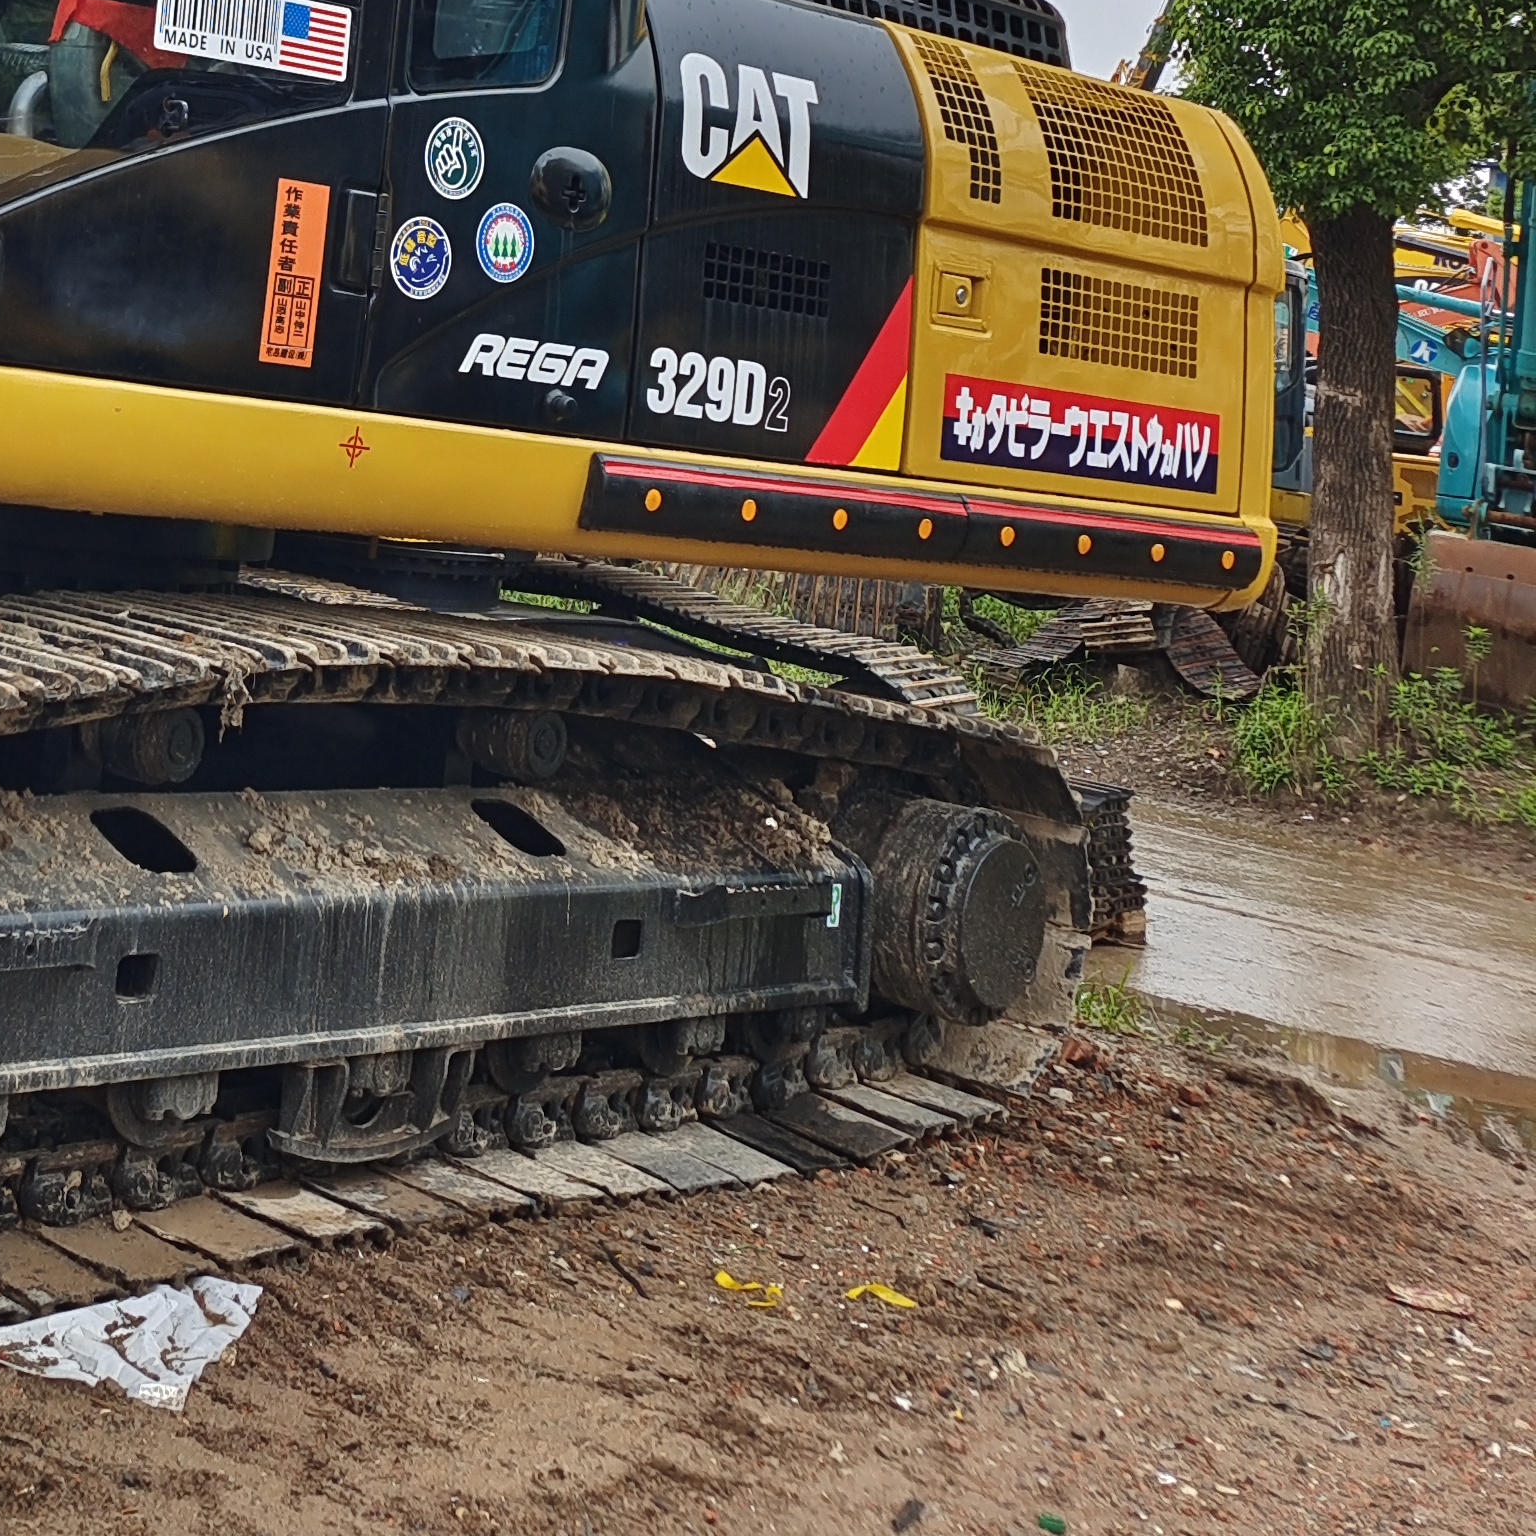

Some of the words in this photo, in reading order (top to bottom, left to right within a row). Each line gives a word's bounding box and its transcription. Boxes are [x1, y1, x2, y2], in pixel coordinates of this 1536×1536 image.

[164, 29, 208, 51] MADE
[220, 38, 236, 55] IN
[245, 43, 273, 63] USA
[680, 53, 819, 199] CAT
[277, 186, 304, 272] 作業責任者
[296, 280, 311, 297] 正
[458, 333, 610, 391] REGA
